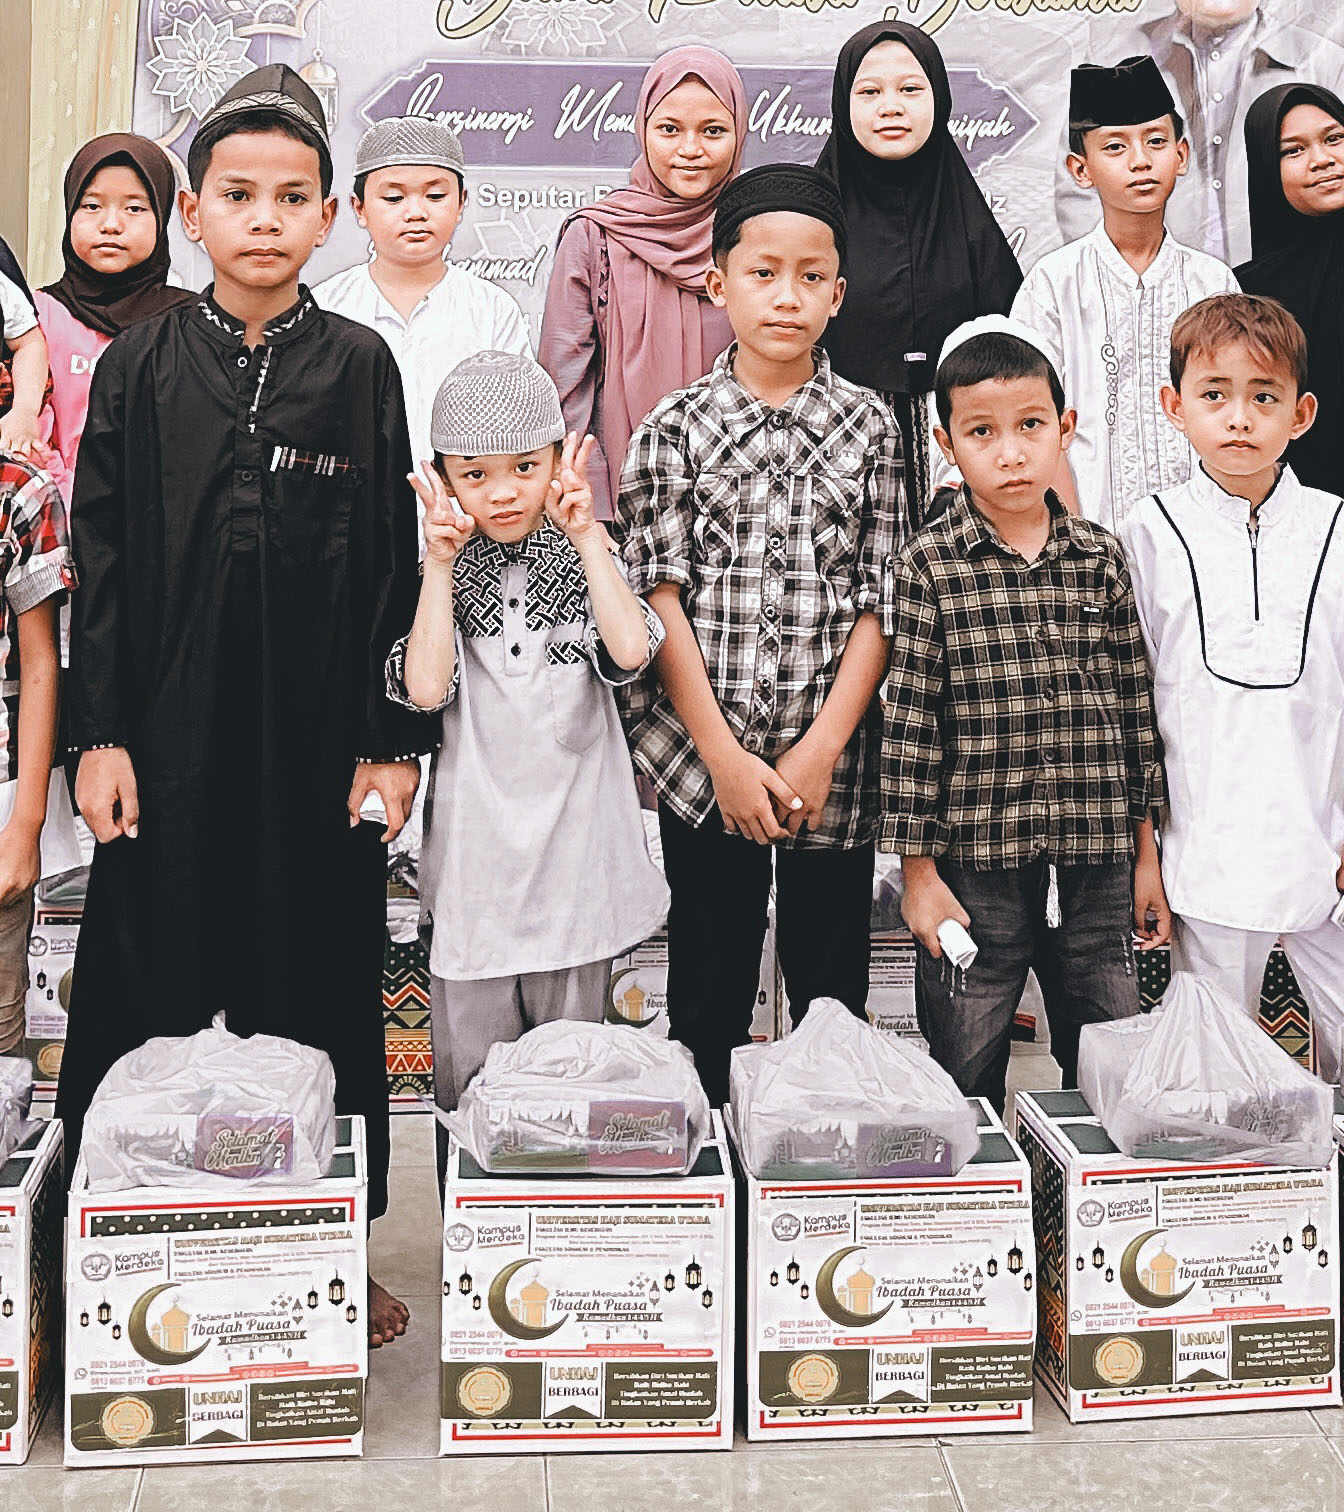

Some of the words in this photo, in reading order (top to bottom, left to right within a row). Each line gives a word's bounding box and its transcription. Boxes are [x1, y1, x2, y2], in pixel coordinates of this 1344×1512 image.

[478, 184, 586, 212] Seputar
[1107, 1197, 1150, 1211] Kampus
[1107, 1204, 1153, 1218] Merdeka
[803, 1213, 848, 1226] Kampus
[476, 1224, 522, 1236] Kampus
[803, 1221, 851, 1233] Merdeka
[476, 1232, 525, 1244] Merdeka
[114, 1250, 161, 1264] Kampus
[114, 1257, 164, 1271] Merdeka
[1177, 1264, 1224, 1280] Ibadah
[1226, 1261, 1268, 1277] Puasa
[875, 1284, 924, 1298] Ibadah
[928, 1283, 970, 1298] Puasa
[549, 1298, 600, 1311] Ibadah
[603, 1298, 647, 1312] Puasa
[190, 1320, 243, 1336] Ibadah
[245, 1316, 291, 1332] Puasa
[1178, 1349, 1226, 1362] BERBAGI
[875, 1370, 924, 1382] BERBAGI
[548, 1387, 599, 1397] BERBAGI
[192, 1409, 244, 1423] BERBAGI
